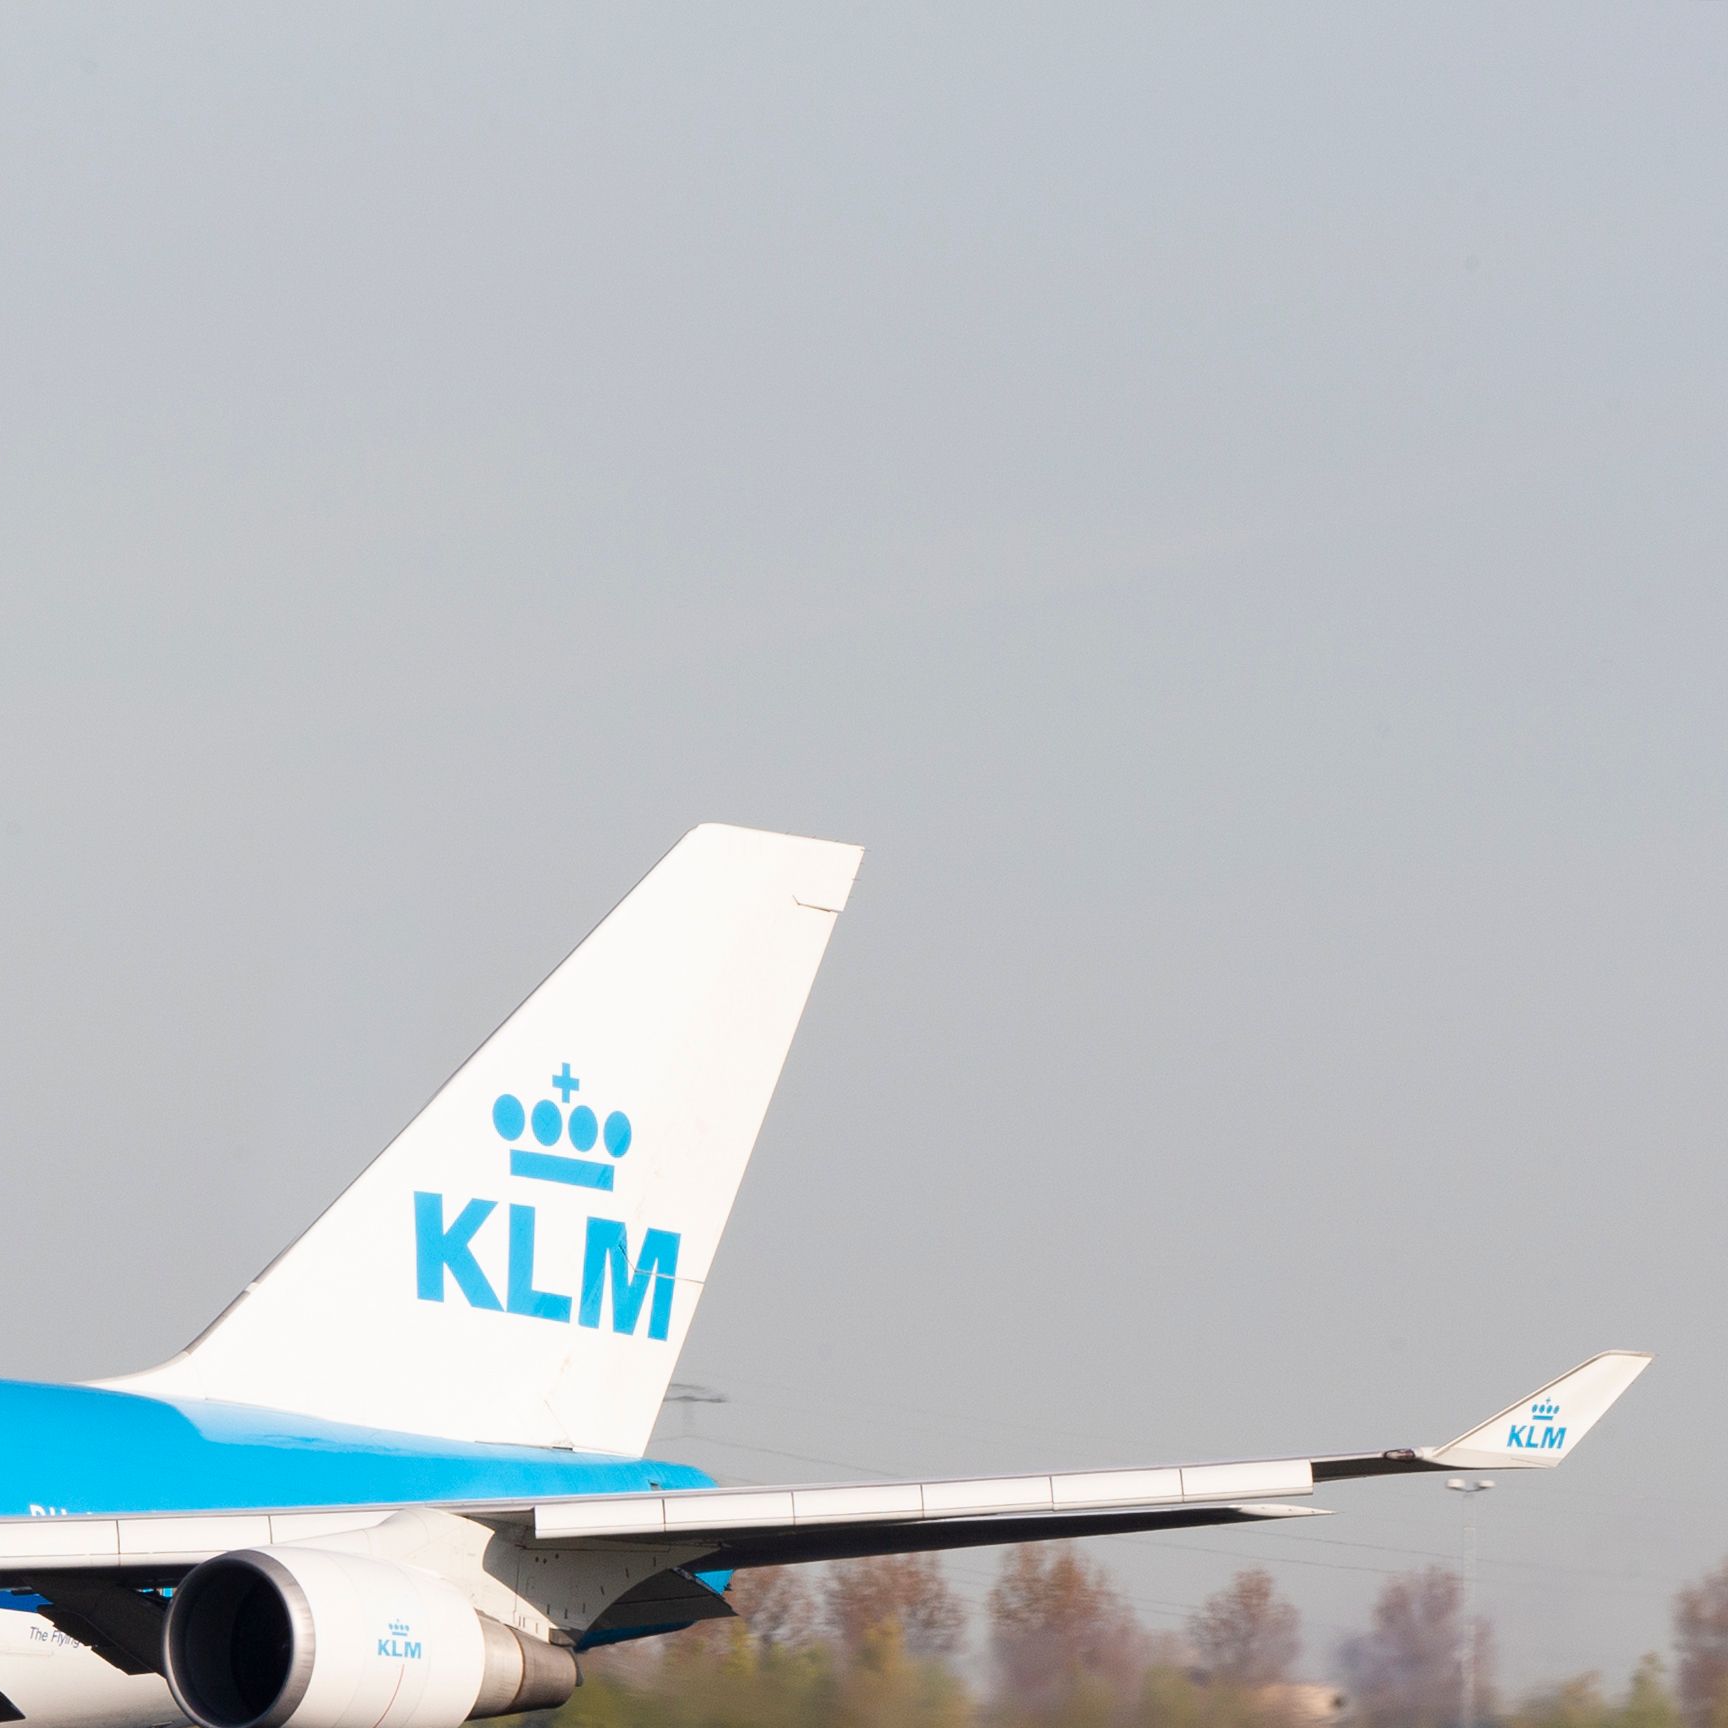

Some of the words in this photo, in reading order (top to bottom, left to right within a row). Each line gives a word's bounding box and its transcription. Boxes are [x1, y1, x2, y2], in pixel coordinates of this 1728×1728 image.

[413, 1191, 682, 1341] KLM
[1507, 1425, 1567, 1449] KLM
[29, 1626, 49, 1642] The
[377, 1638, 423, 1660] KLM
